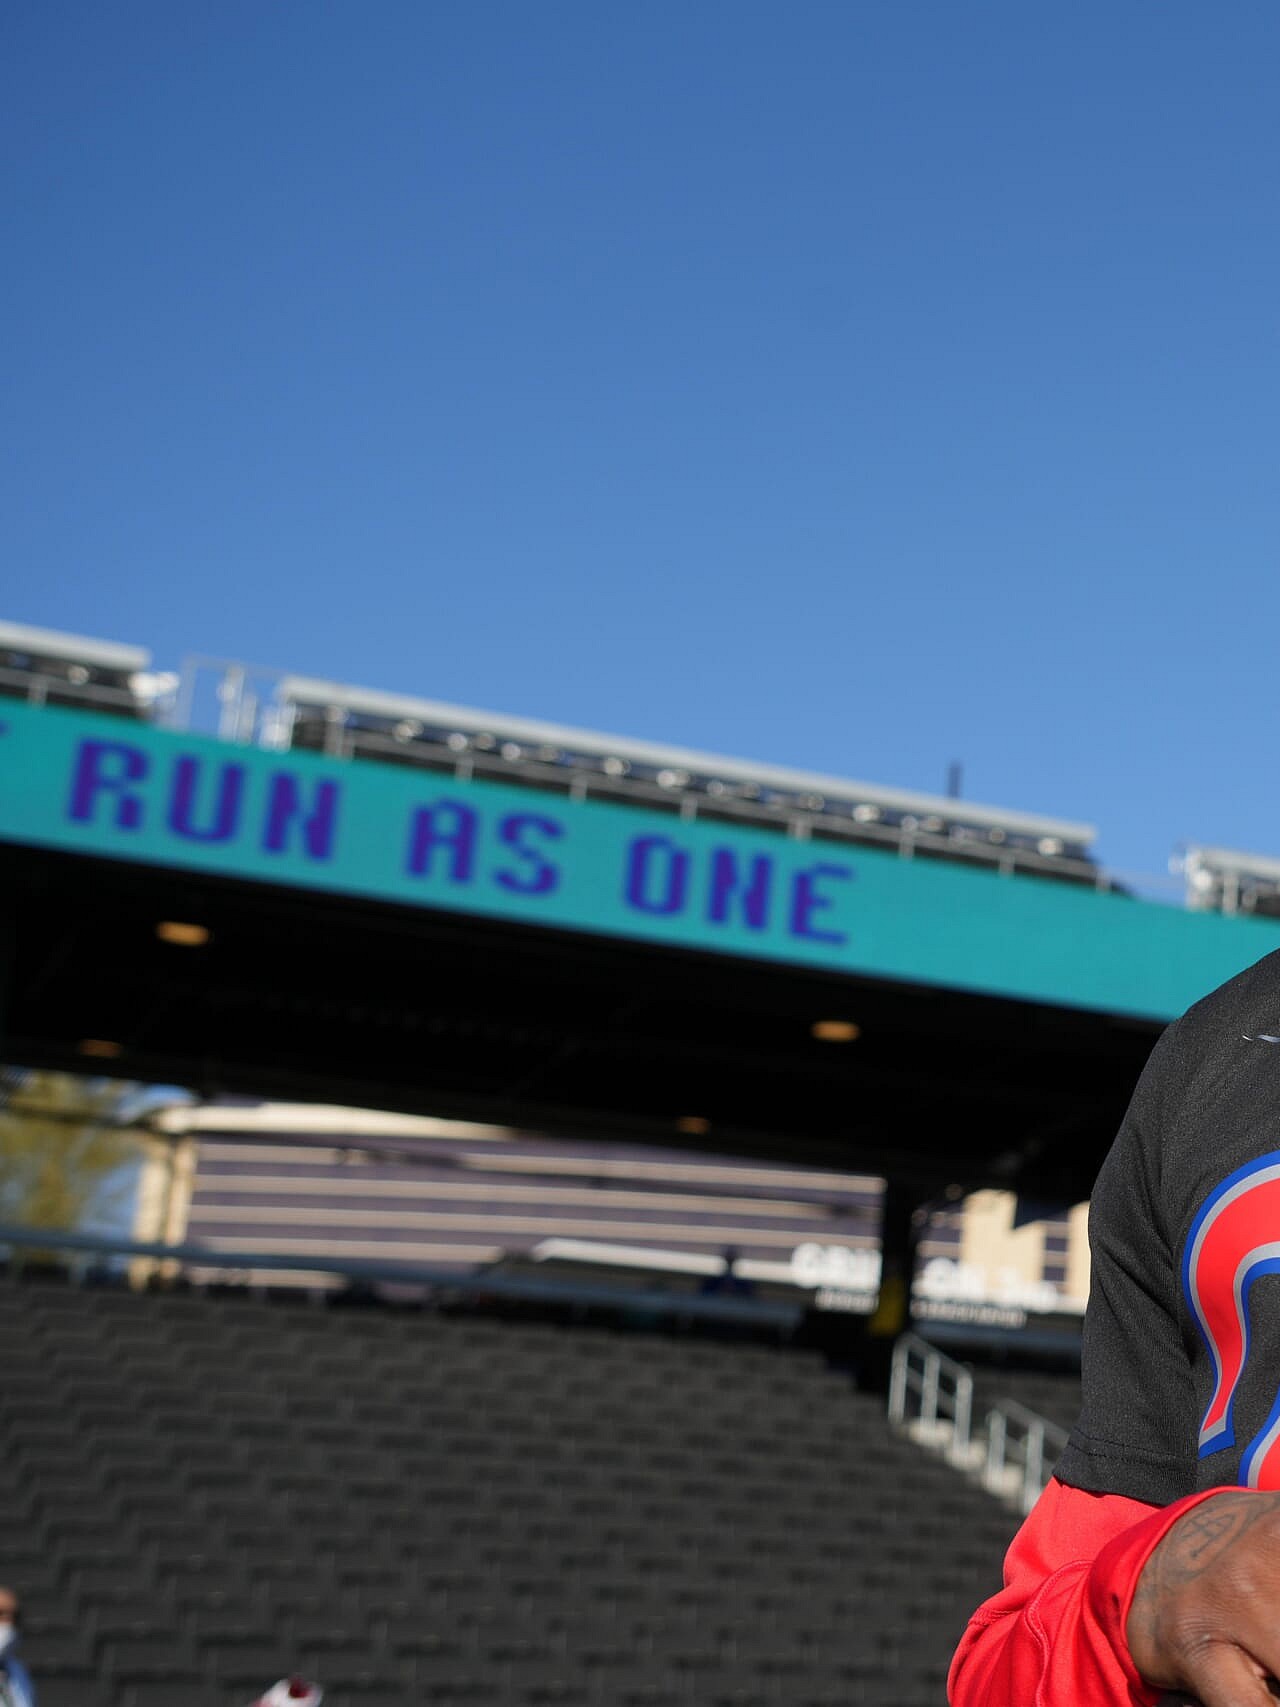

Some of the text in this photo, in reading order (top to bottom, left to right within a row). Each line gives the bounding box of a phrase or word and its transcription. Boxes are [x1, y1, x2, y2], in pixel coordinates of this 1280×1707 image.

[68, 737, 854, 948] RUN AS ONE
